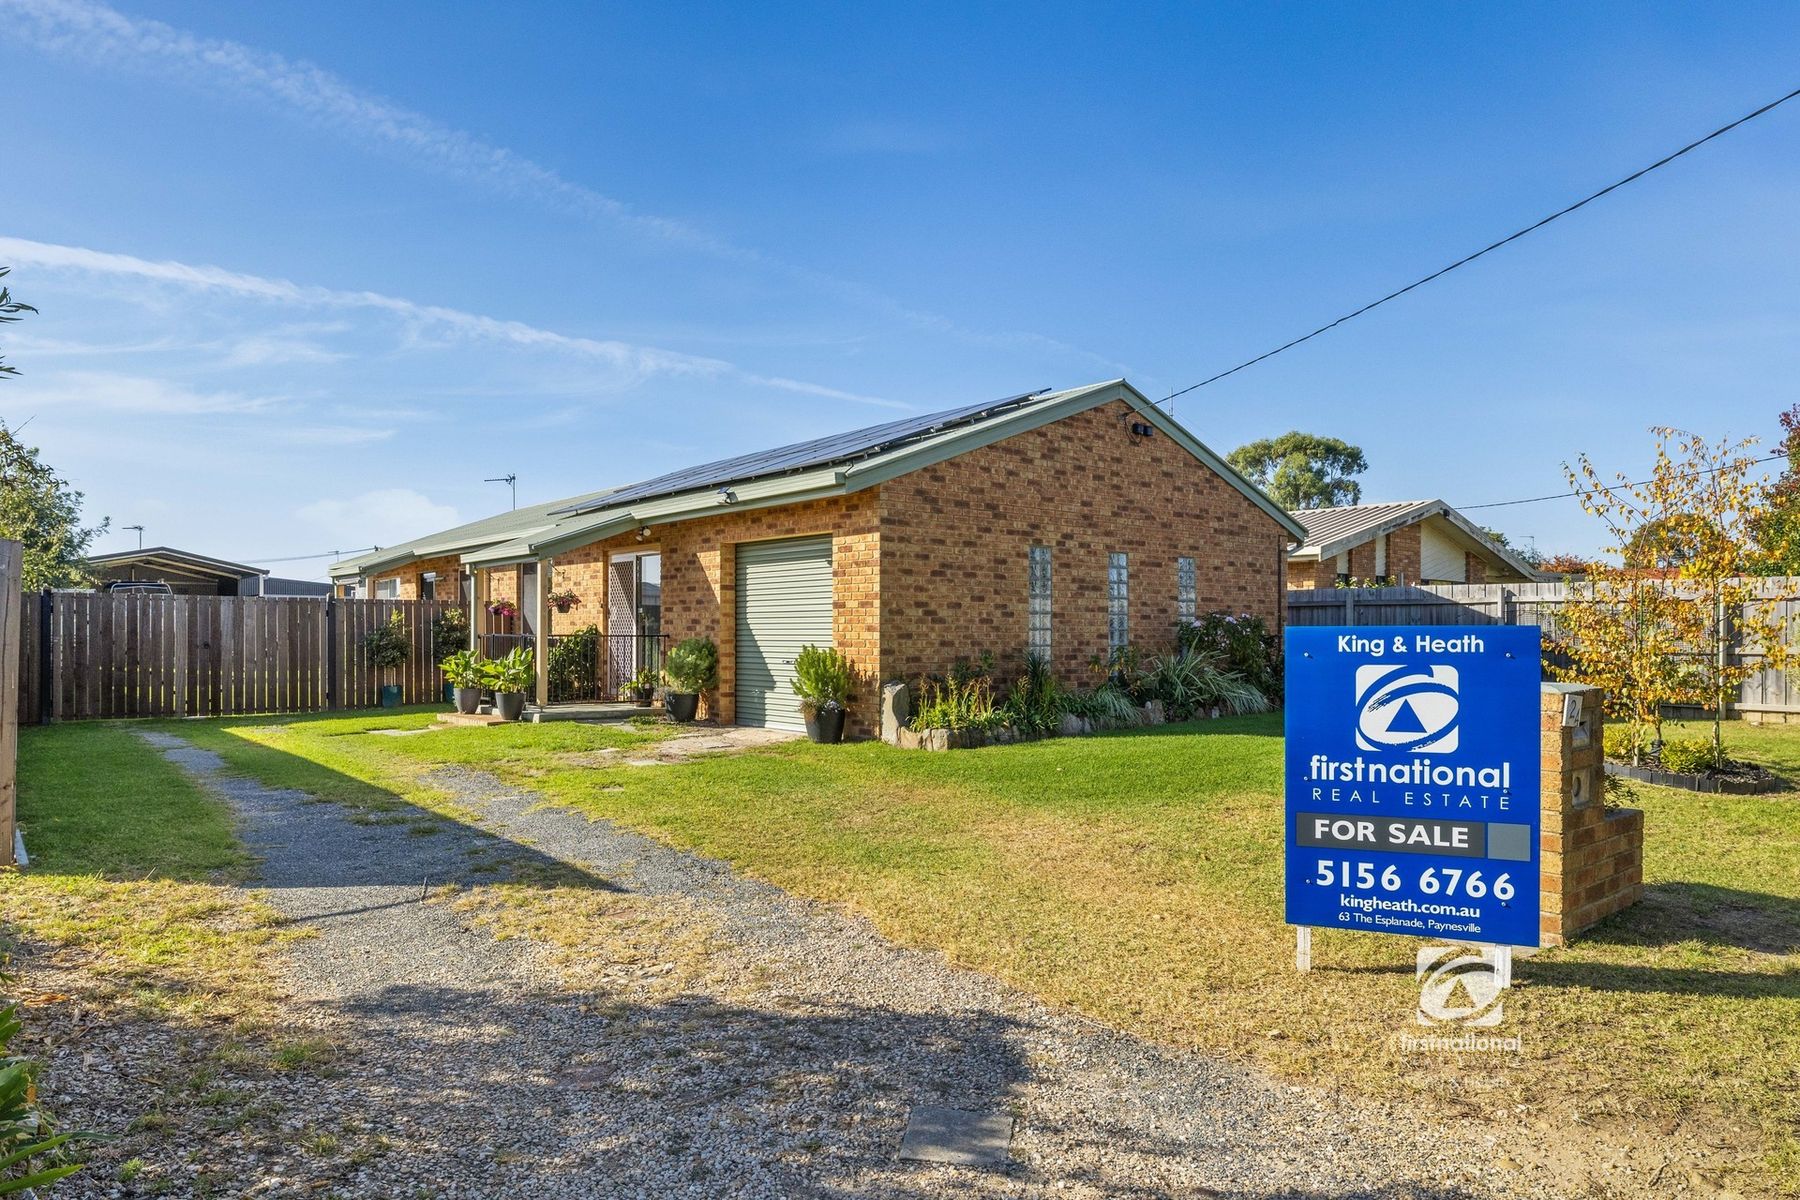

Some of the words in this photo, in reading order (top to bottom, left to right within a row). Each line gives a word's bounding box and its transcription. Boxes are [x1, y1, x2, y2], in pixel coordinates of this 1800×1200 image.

[1338, 635, 1385, 656] King
[1392, 636, 1408, 653] &
[1416, 634, 1484, 653] Heath
[1312, 787, 1380, 803] REAL
[1405, 790, 1509, 810] ESTATE
[1314, 818, 1377, 843] FOR
[1388, 823, 1469, 849] SALE
[1316, 859, 1402, 891] 5156
[1419, 867, 1515, 900] 6766
[1339, 893, 1481, 919] kingheath.com.au
[1338, 911, 1350, 922] 63
[1353, 912, 1373, 924] The
[1375, 915, 1425, 930] Esplanade,
[1428, 919, 1481, 934] Paynesville
